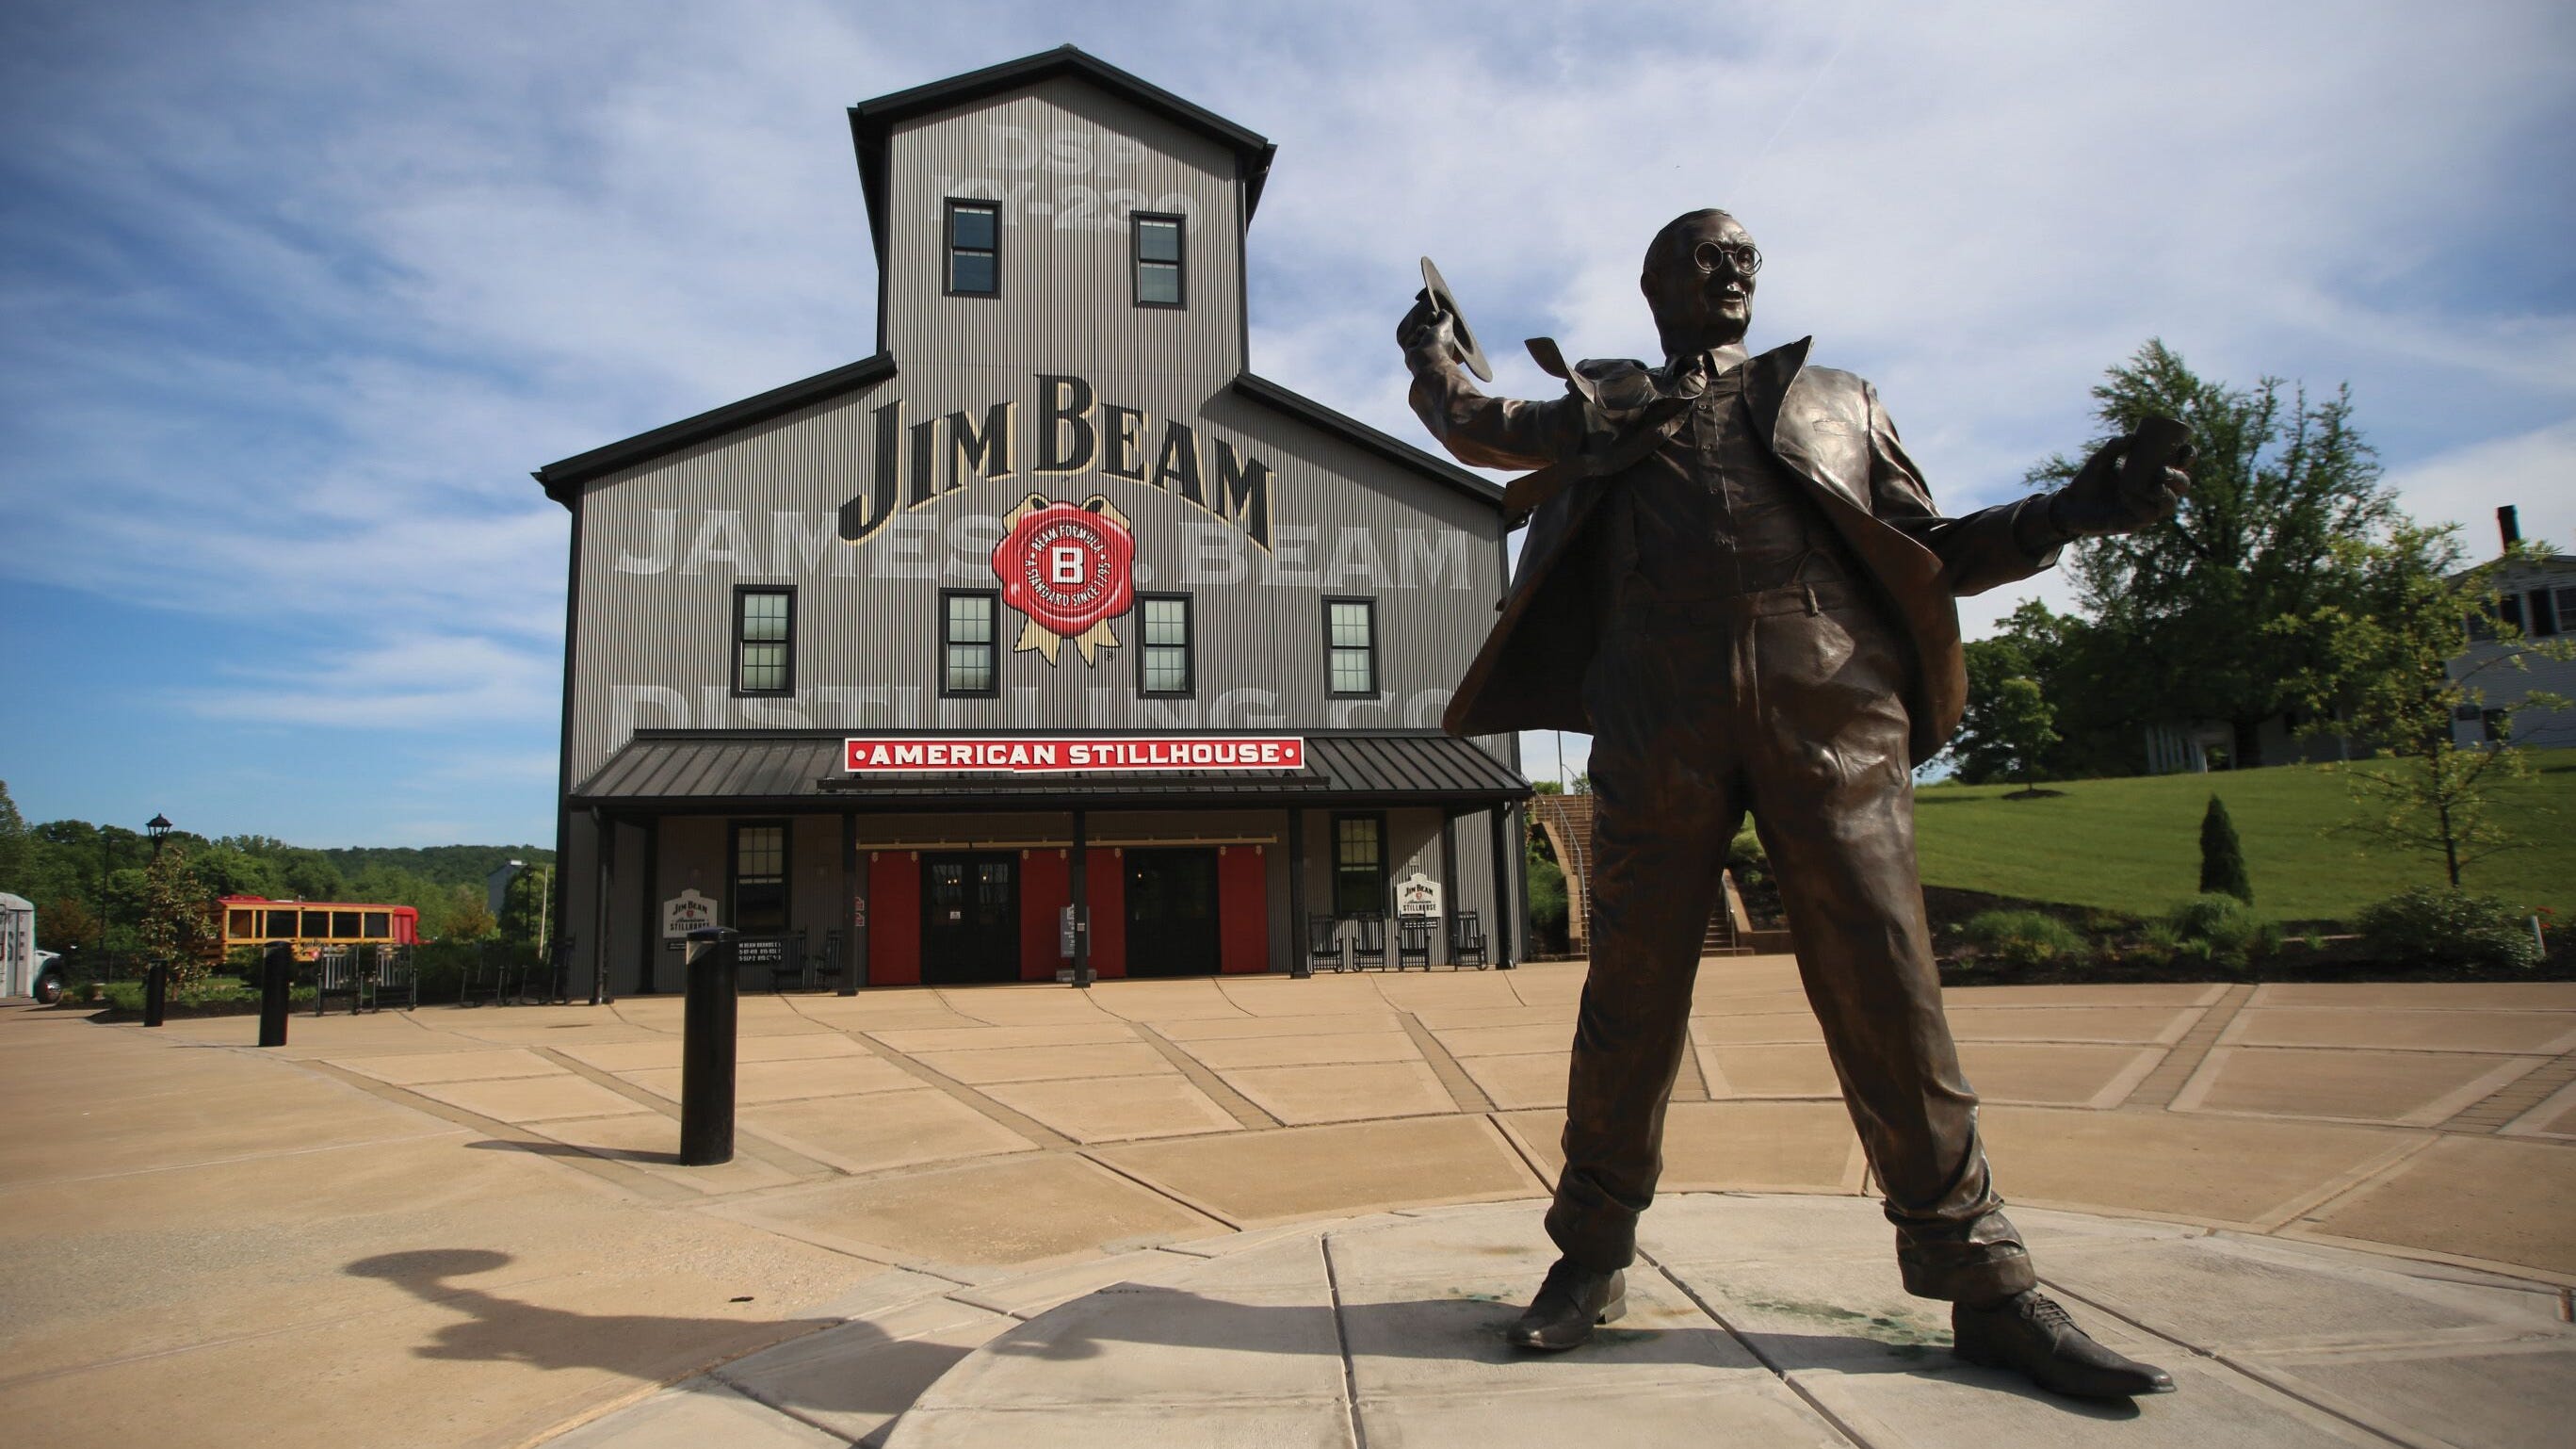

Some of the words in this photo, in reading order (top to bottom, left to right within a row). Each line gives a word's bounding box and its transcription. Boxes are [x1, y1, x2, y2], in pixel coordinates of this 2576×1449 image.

[984, 124, 1147, 177] DSP
[837, 399, 1018, 546] JIM
[1032, 373, 1277, 556] BEAM
[613, 509, 1004, 580] JAMES
[1030, 528, 1059, 553] BEAM
[1059, 525, 1105, 554] FORMULA
[1178, 522, 1472, 590] BEAM
[1052, 546, 1084, 584] B
[1026, 569, 1070, 607] STANDARD
[1072, 585, 1100, 607] SINCE
[867, 744, 1056, 766] AMERICAN
[1068, 743, 1281, 765] STILLHOUSE
